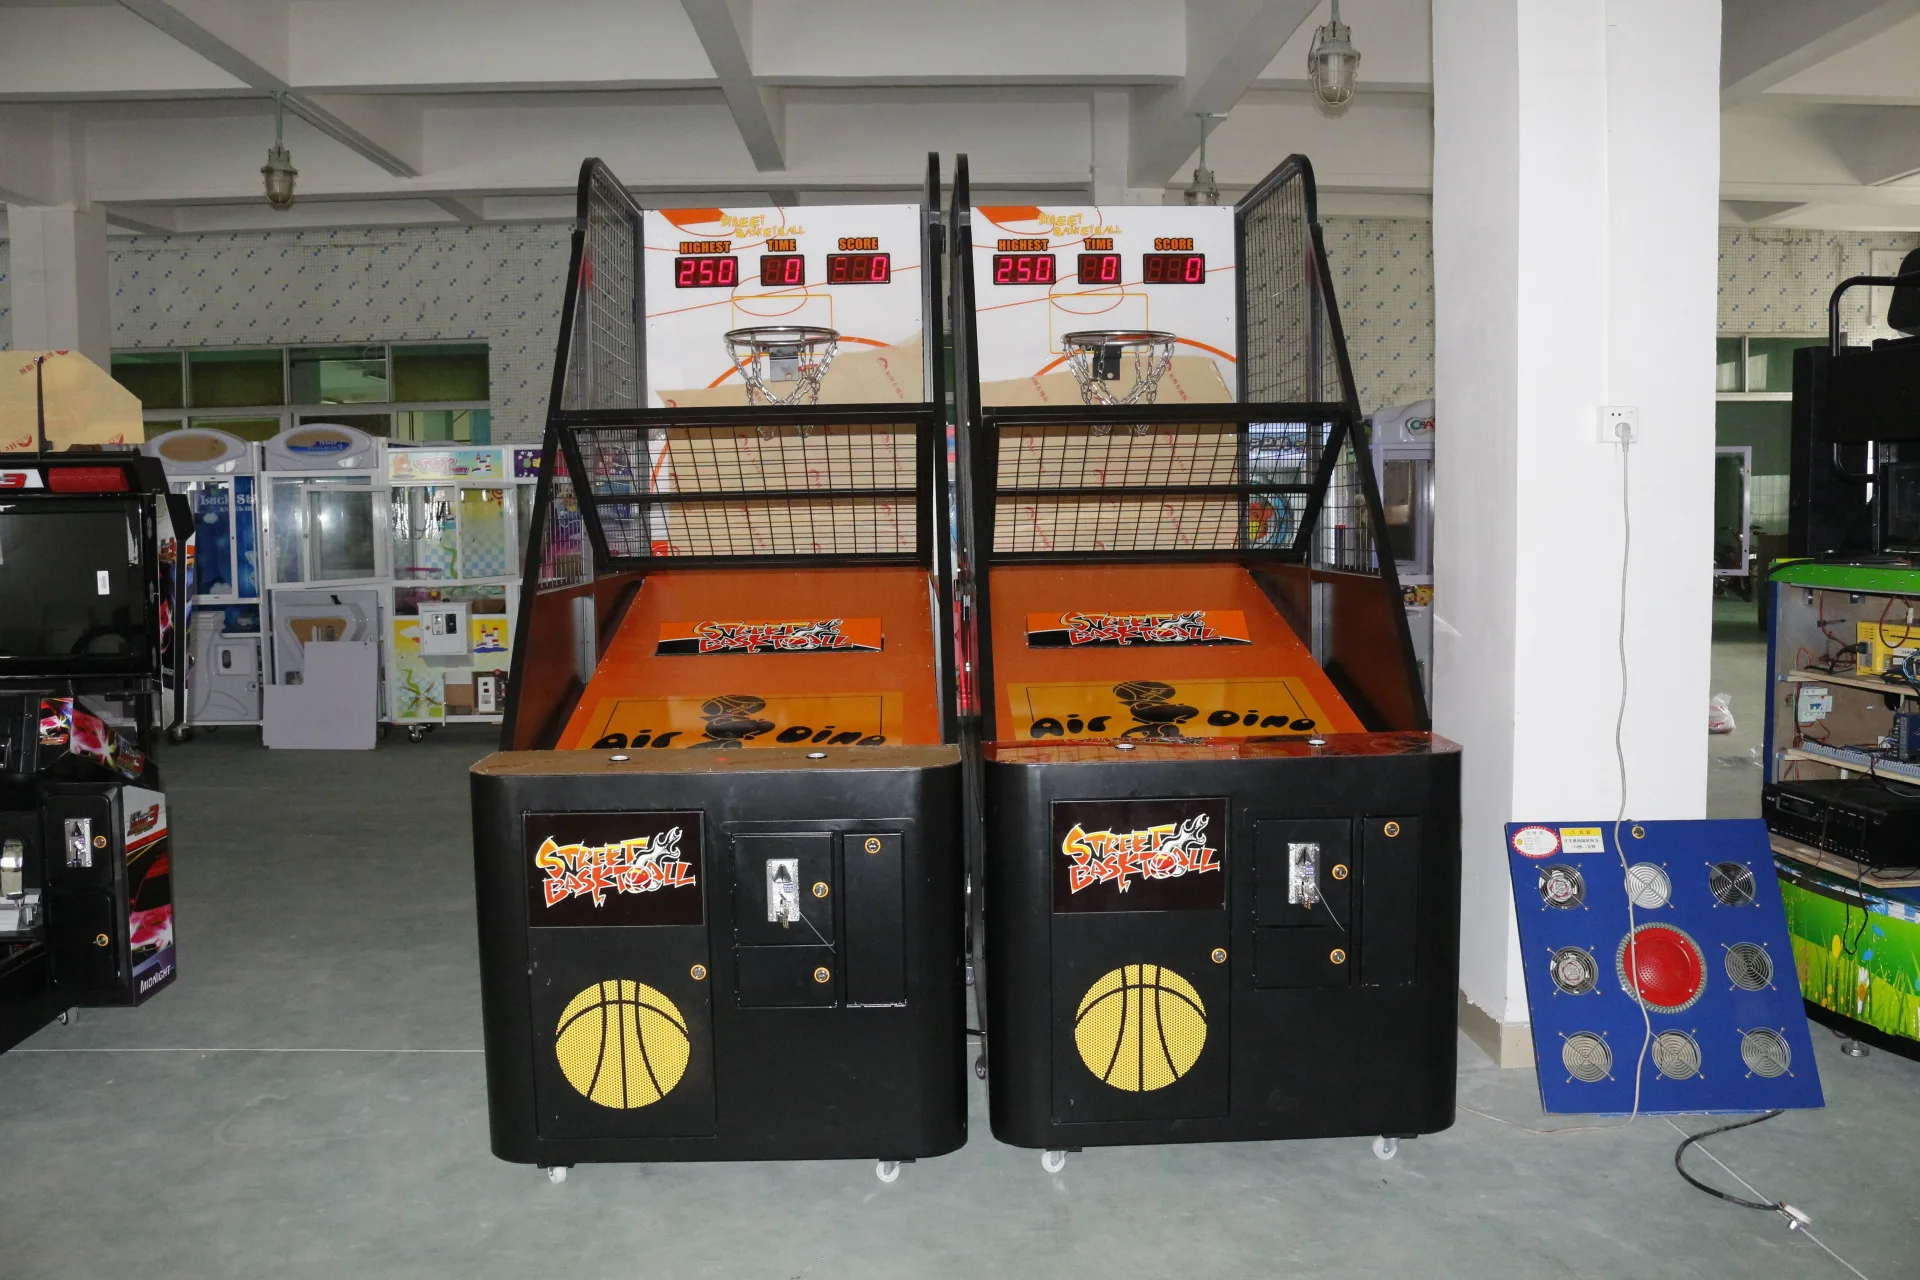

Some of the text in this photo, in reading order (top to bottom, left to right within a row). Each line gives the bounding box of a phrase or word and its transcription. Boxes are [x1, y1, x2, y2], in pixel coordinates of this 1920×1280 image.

[680, 237, 879, 254] HIGHEST TIME SCORE
[998, 238, 1194, 252] HIGHEST TIME SCORE
[679, 260, 735, 285] 250
[997, 257, 1052, 282] 250
[1062, 823, 1177, 865] STREET
[535, 835, 651, 879] STREET
[140, 965, 172, 994] MIDNIGHT
